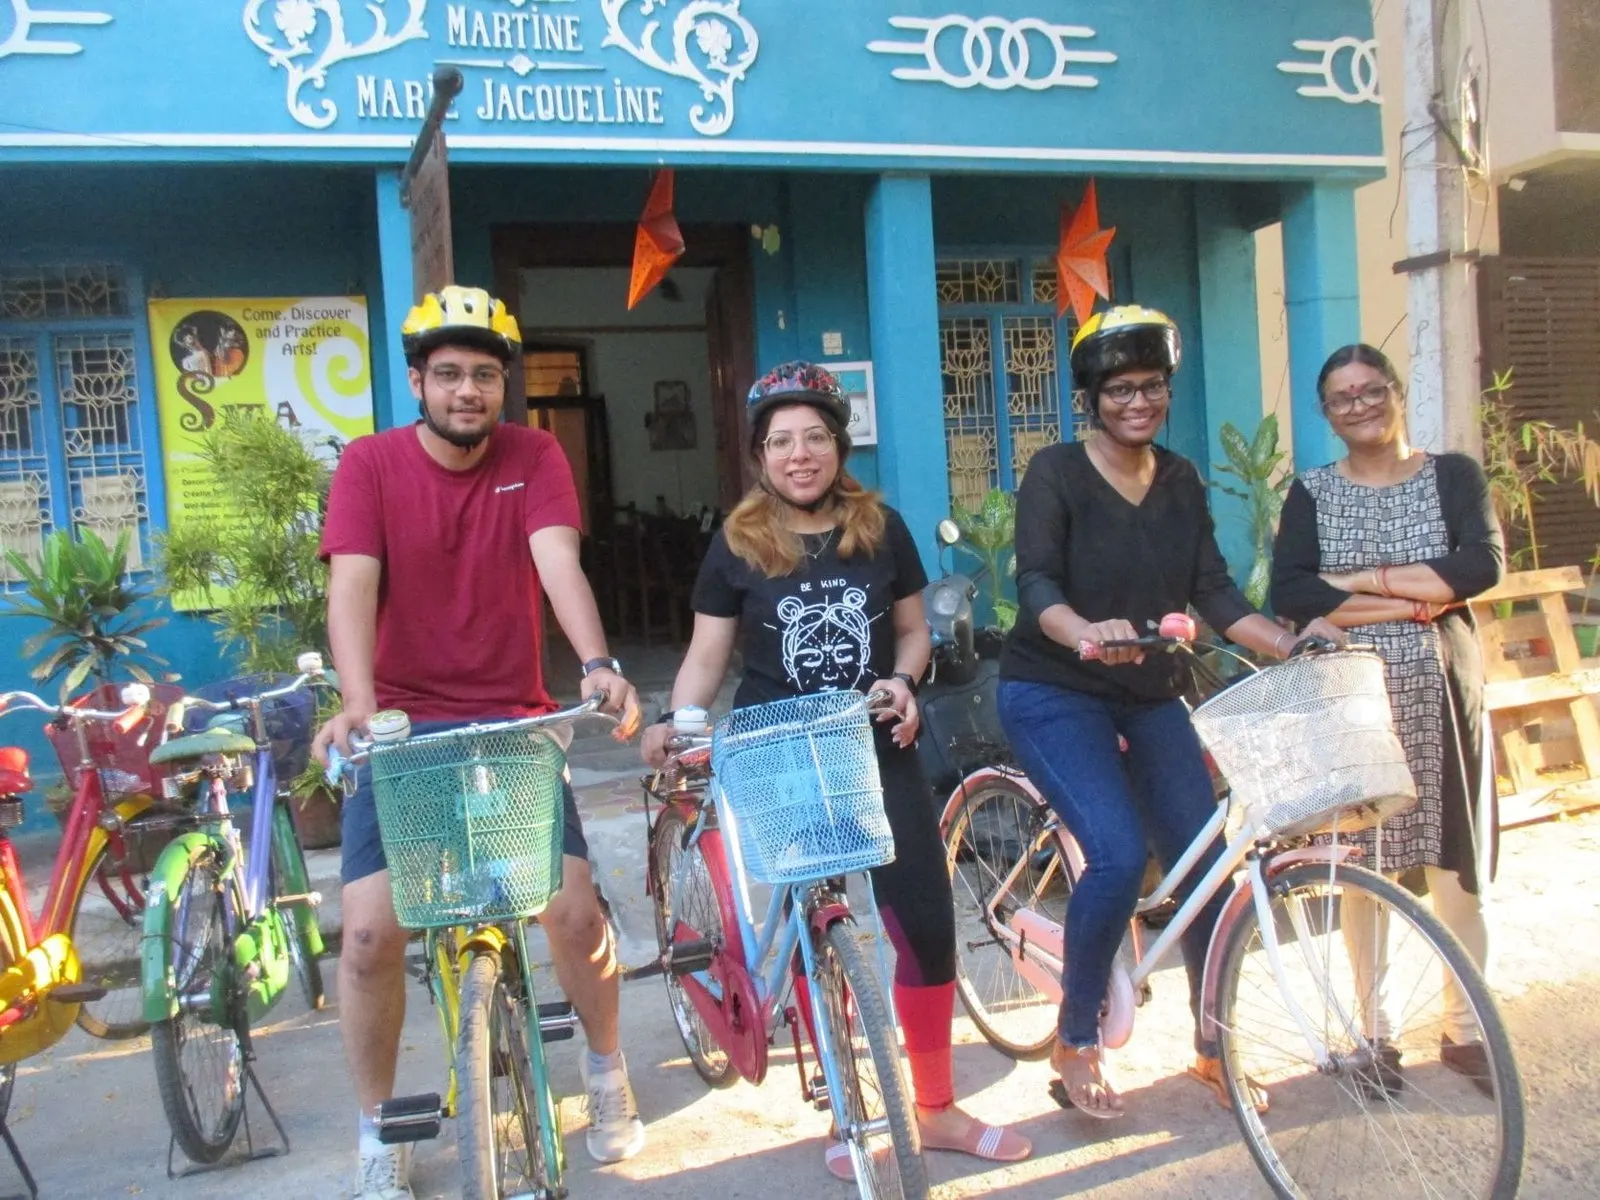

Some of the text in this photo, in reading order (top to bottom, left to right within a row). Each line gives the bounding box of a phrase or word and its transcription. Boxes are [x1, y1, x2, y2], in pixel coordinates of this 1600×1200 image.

[356, 74, 665, 124] MAR JACQUELINE
[291, 307, 351, 320] Discover
[255, 324, 341, 339] and Practice
[281, 342, 318, 356] Arts!
[800, 578, 847, 592] BE KIND
